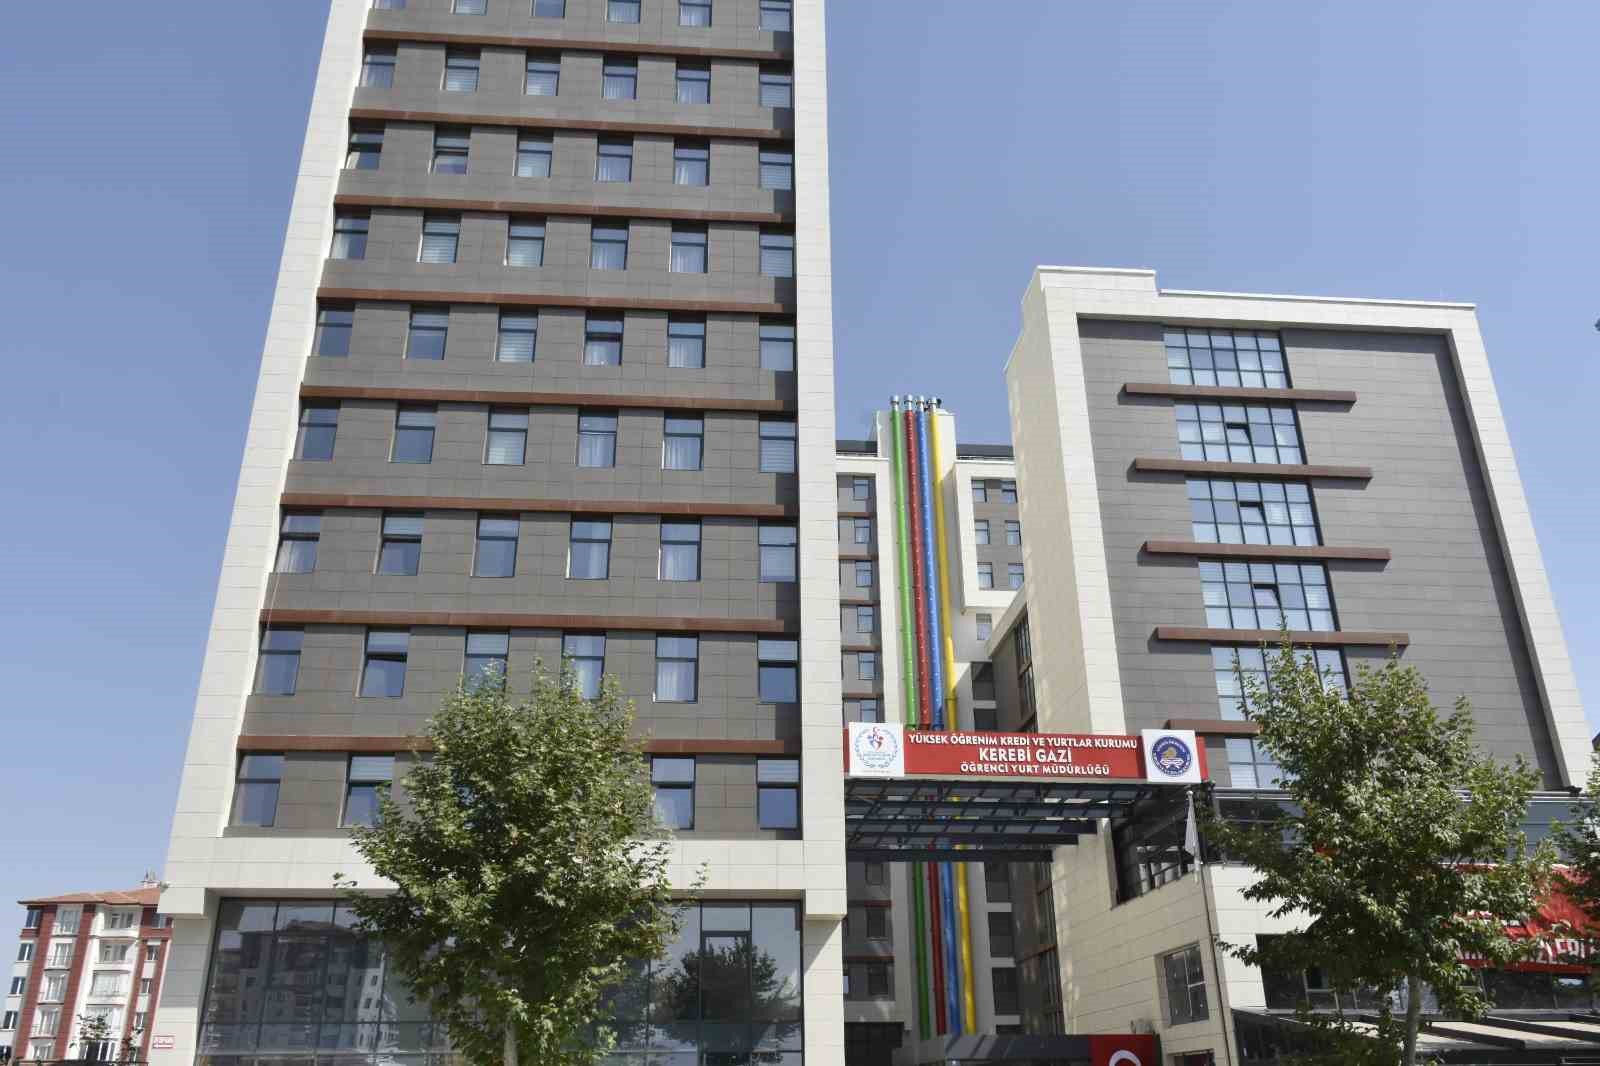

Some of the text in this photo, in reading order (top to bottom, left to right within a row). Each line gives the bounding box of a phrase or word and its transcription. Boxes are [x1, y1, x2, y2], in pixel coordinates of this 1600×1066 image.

[908, 732, 1137, 748] YÜKSEK ÖĞRENİM KREDİ VE YURTLAR KURUMU
[979, 747, 1072, 763] KEREBİ GAZİ
[960, 761, 1110, 775] ÖĞRENCİ YURT MÜDÜRLÜĞÜ
